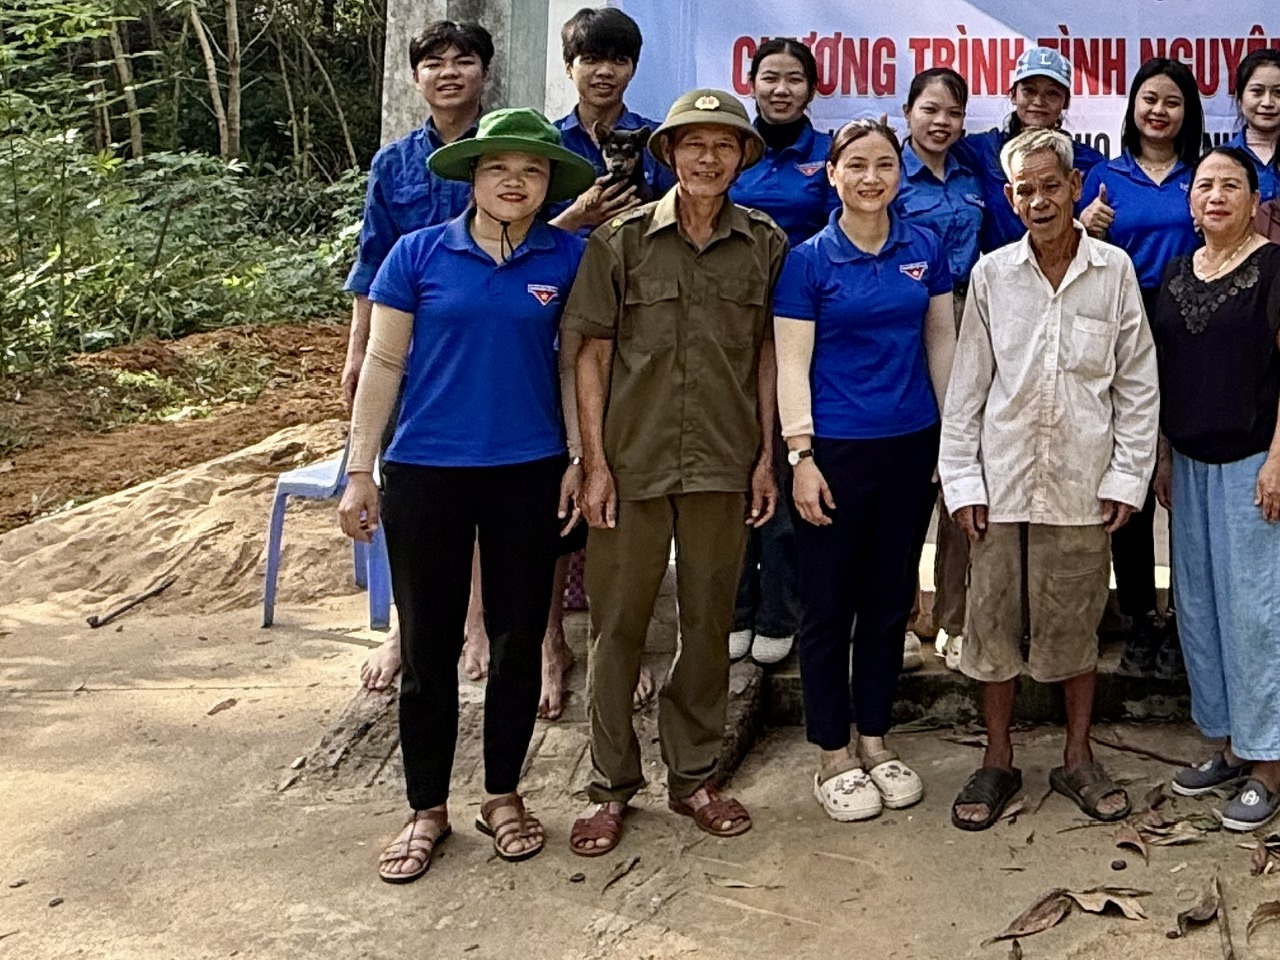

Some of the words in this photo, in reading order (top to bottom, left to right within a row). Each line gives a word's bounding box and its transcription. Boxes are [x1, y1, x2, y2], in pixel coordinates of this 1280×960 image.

[732, 31, 896, 97] CƠNG
[1037, 25, 1126, 95] ÌNH
[1039, 53, 1052, 65] L
